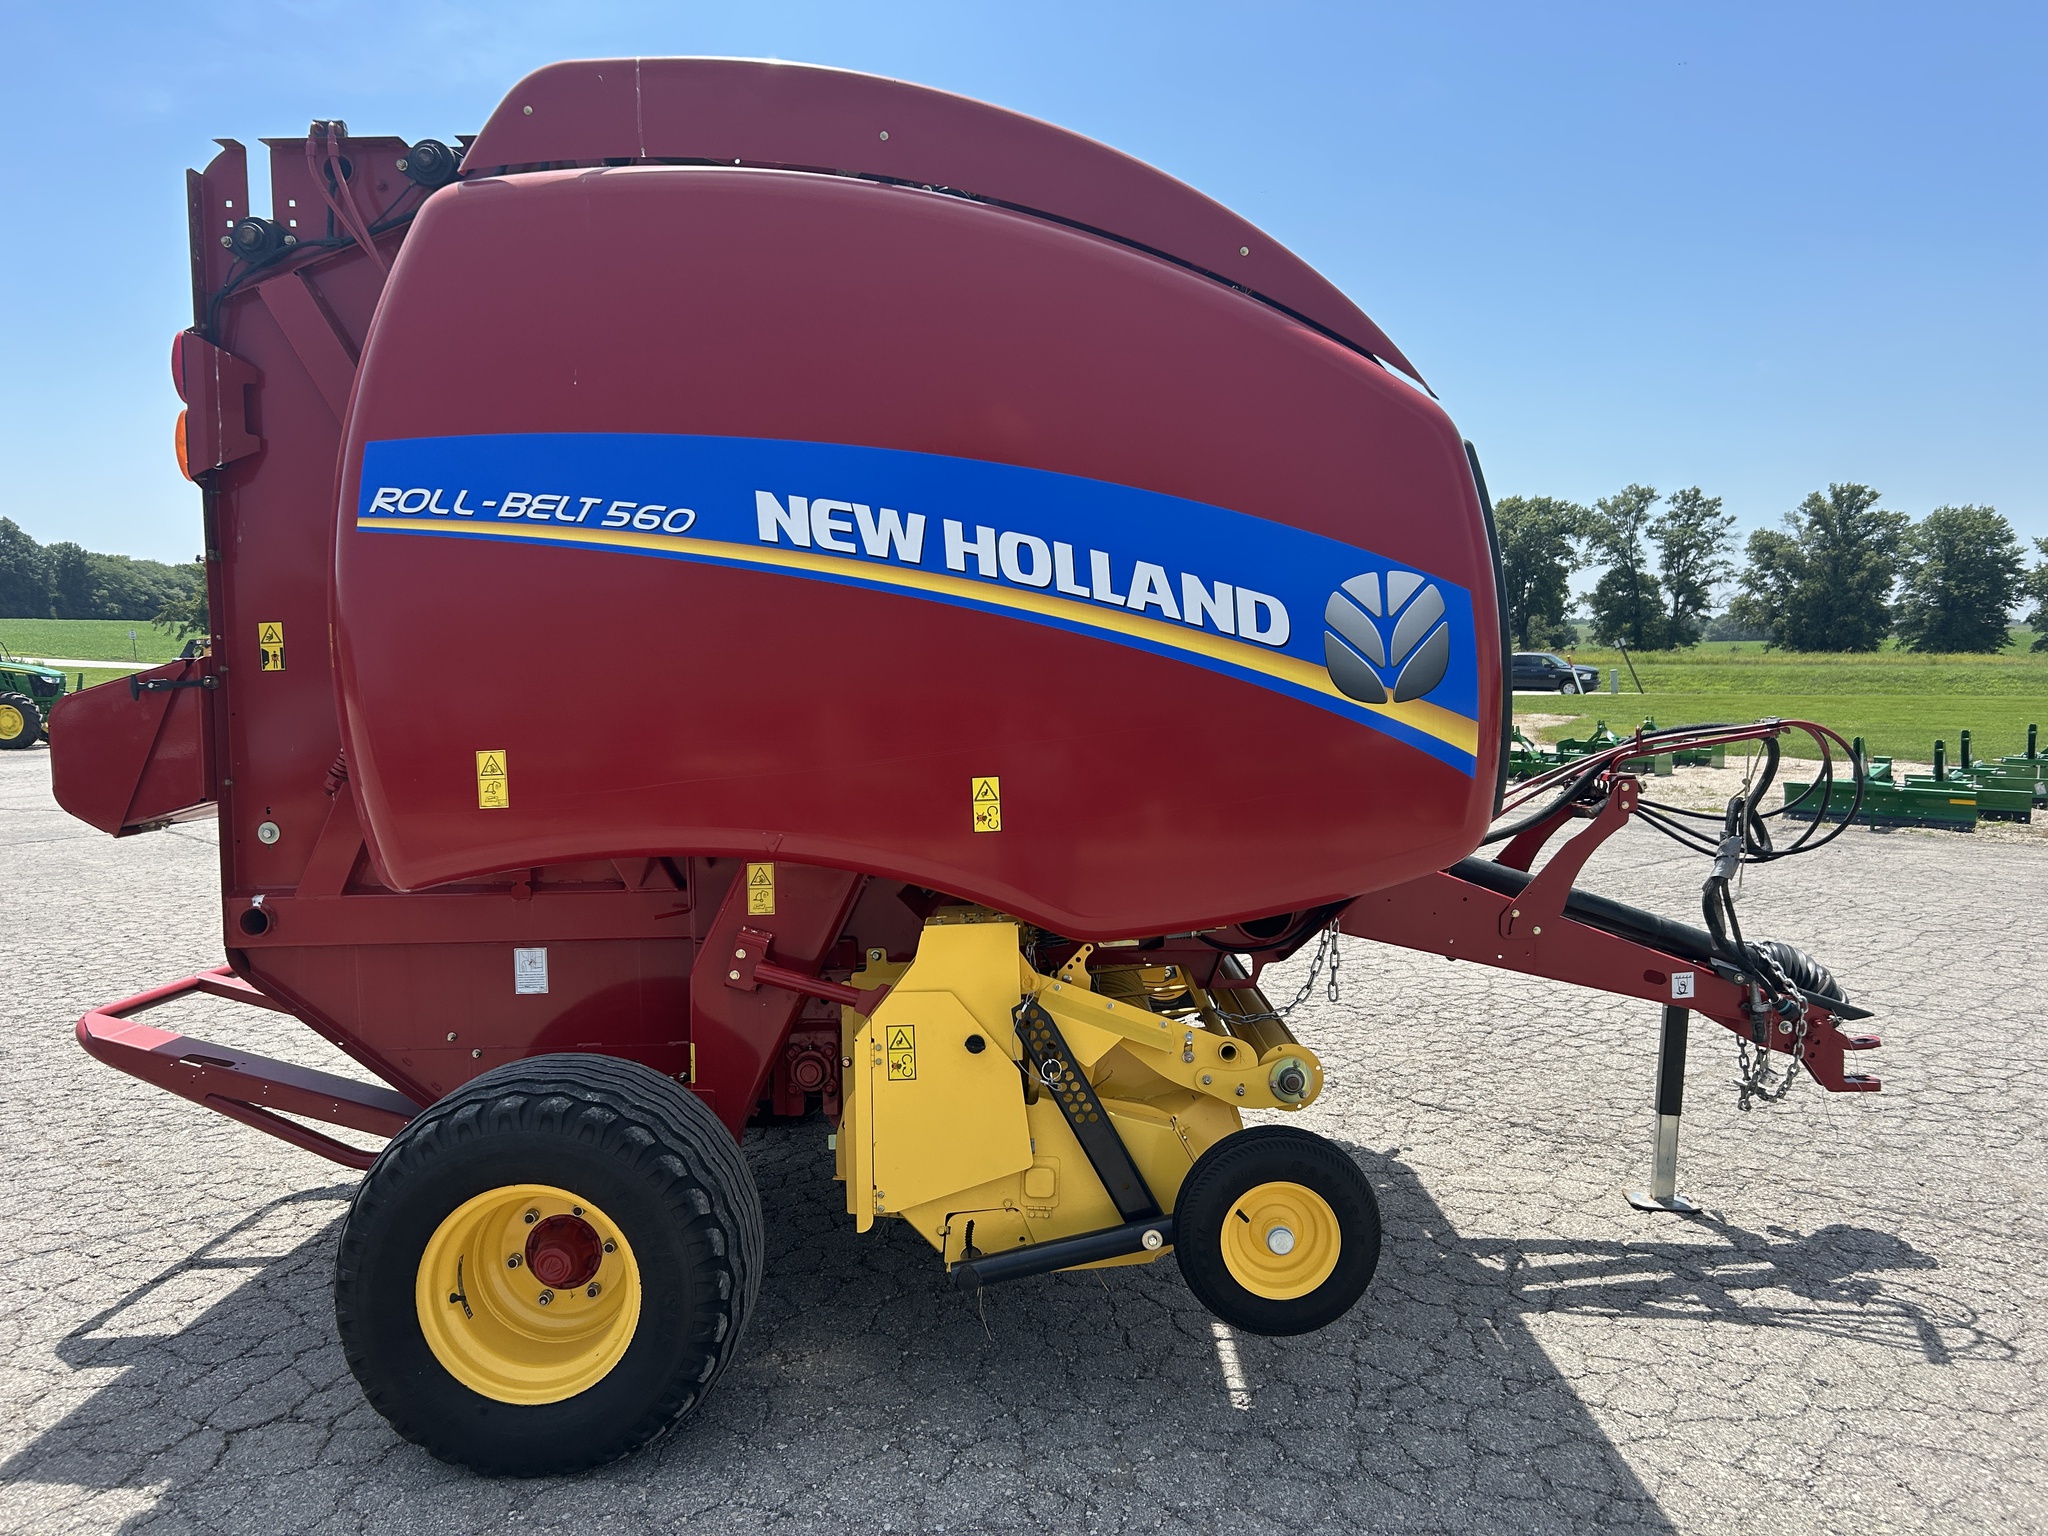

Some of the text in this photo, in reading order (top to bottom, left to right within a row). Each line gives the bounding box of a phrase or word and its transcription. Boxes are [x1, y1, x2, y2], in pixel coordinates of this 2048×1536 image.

[601, 500, 697, 534] 560
[755, 490, 1290, 646] NEW HOLLAND
